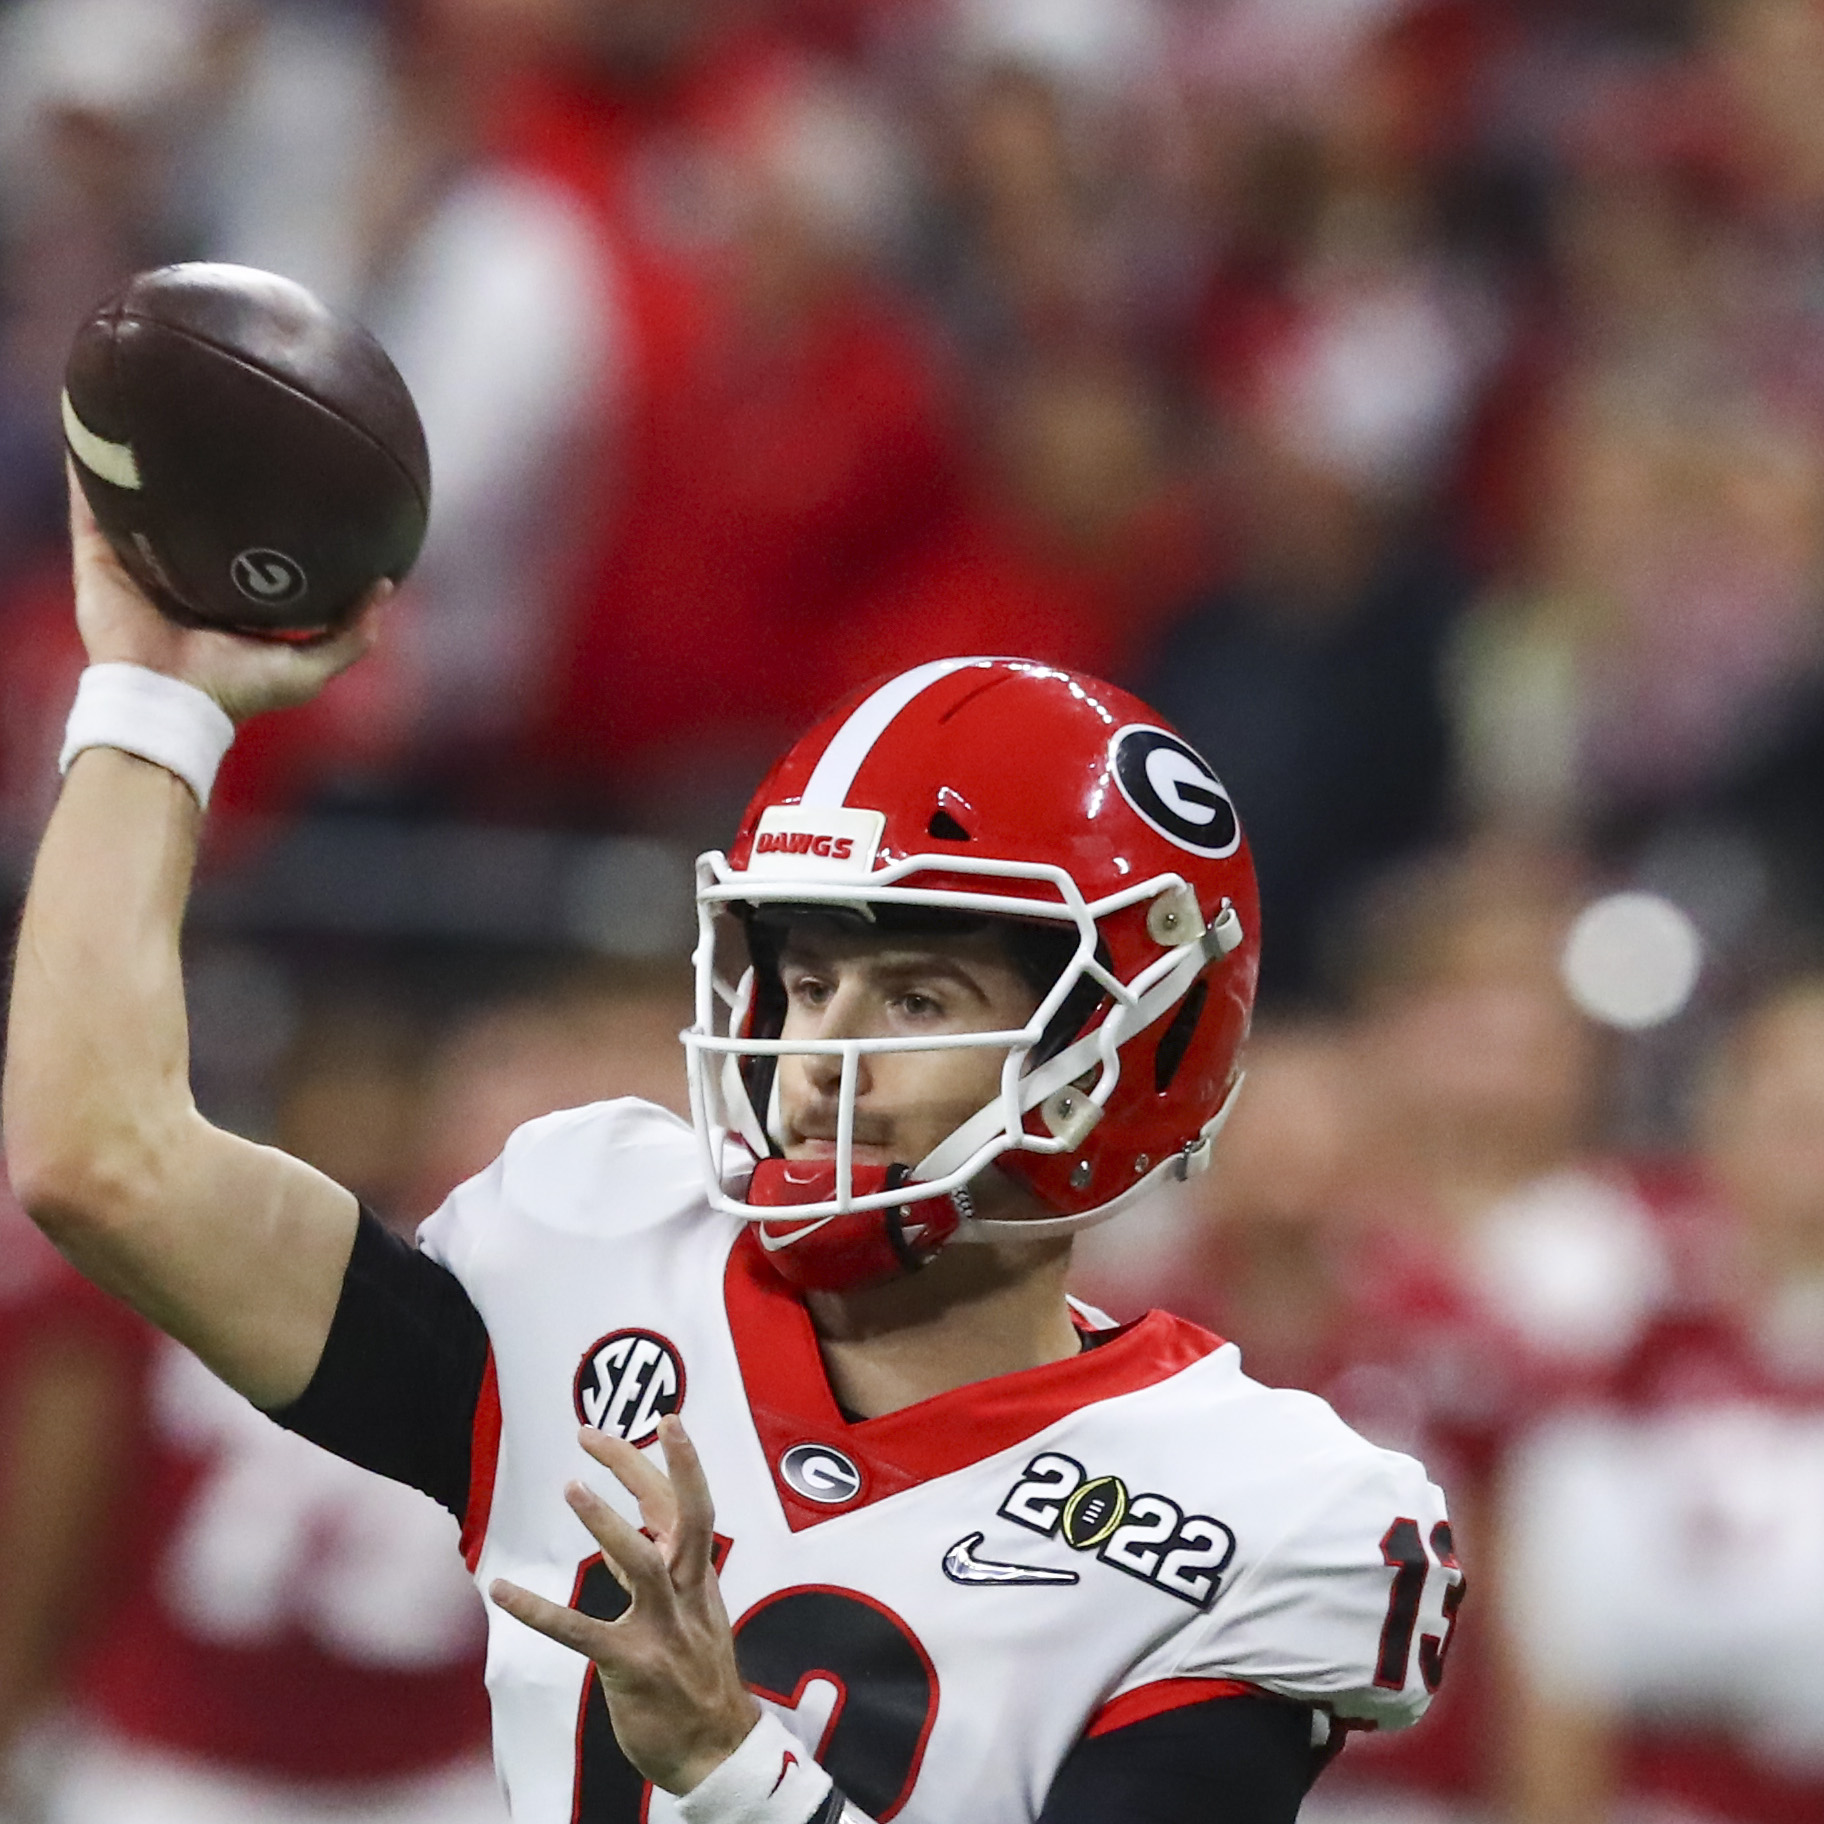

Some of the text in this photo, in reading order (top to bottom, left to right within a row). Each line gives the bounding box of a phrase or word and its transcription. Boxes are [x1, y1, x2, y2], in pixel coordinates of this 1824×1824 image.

[1114, 729, 1238, 849] G
[756, 832, 854, 860] DAWGS
[580, 1336, 677, 1442] SEC
[783, 1446, 858, 1501] G
[997, 1451, 1237, 1610] 2022
